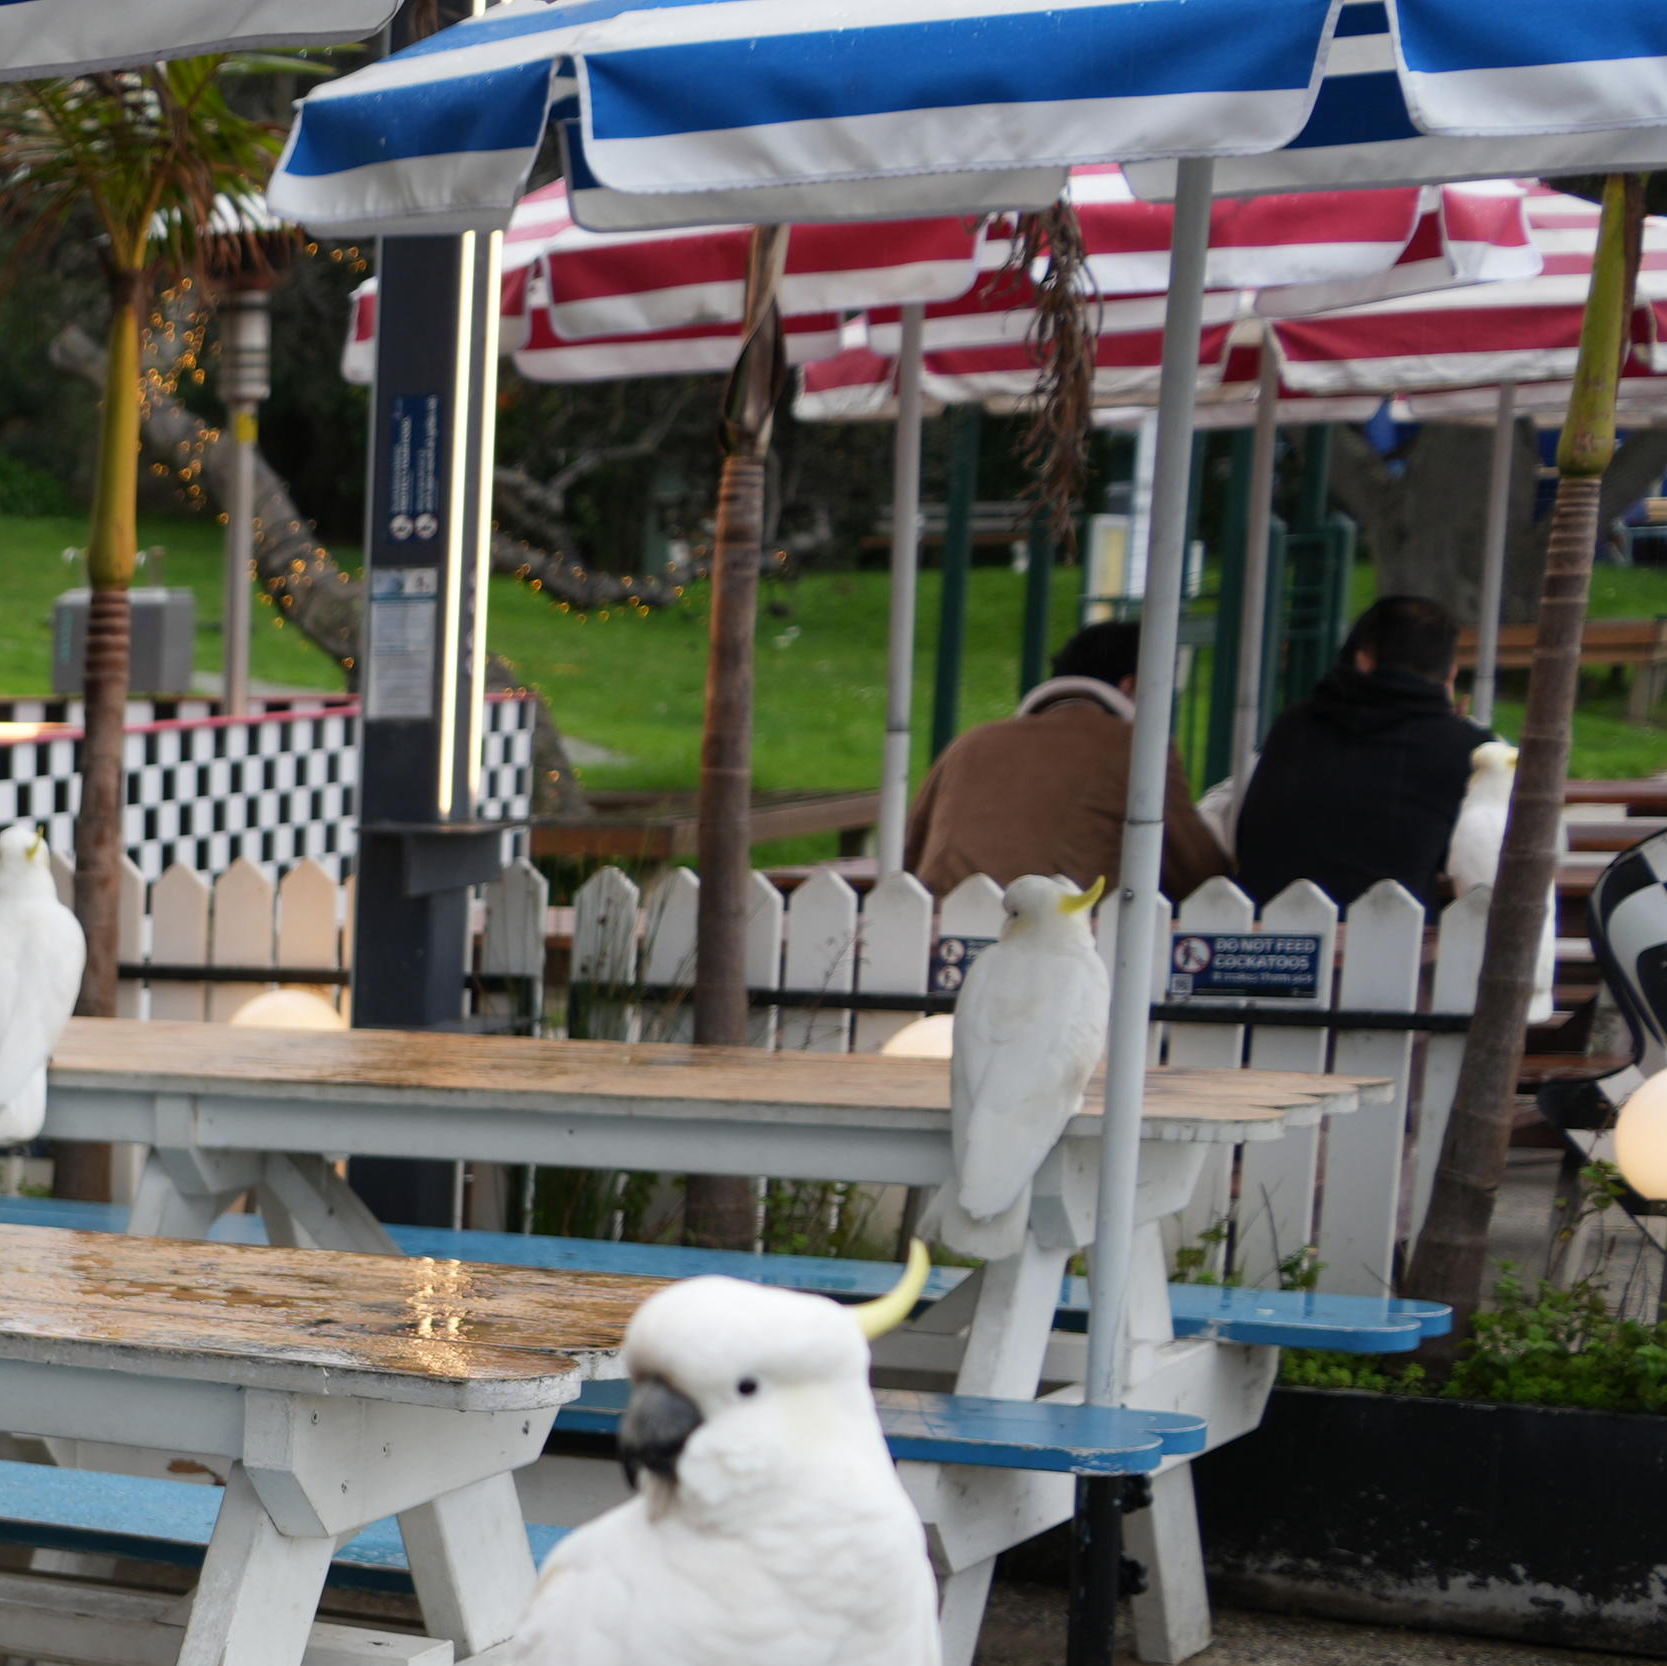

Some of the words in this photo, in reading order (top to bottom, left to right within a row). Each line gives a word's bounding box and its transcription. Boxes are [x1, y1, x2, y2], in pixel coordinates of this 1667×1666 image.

[1215, 939, 1238, 952] DO
[1241, 939, 1273, 952] NOT
[1276, 939, 1316, 954] FEED
[1214, 955, 1309, 970] COCKATOOS
